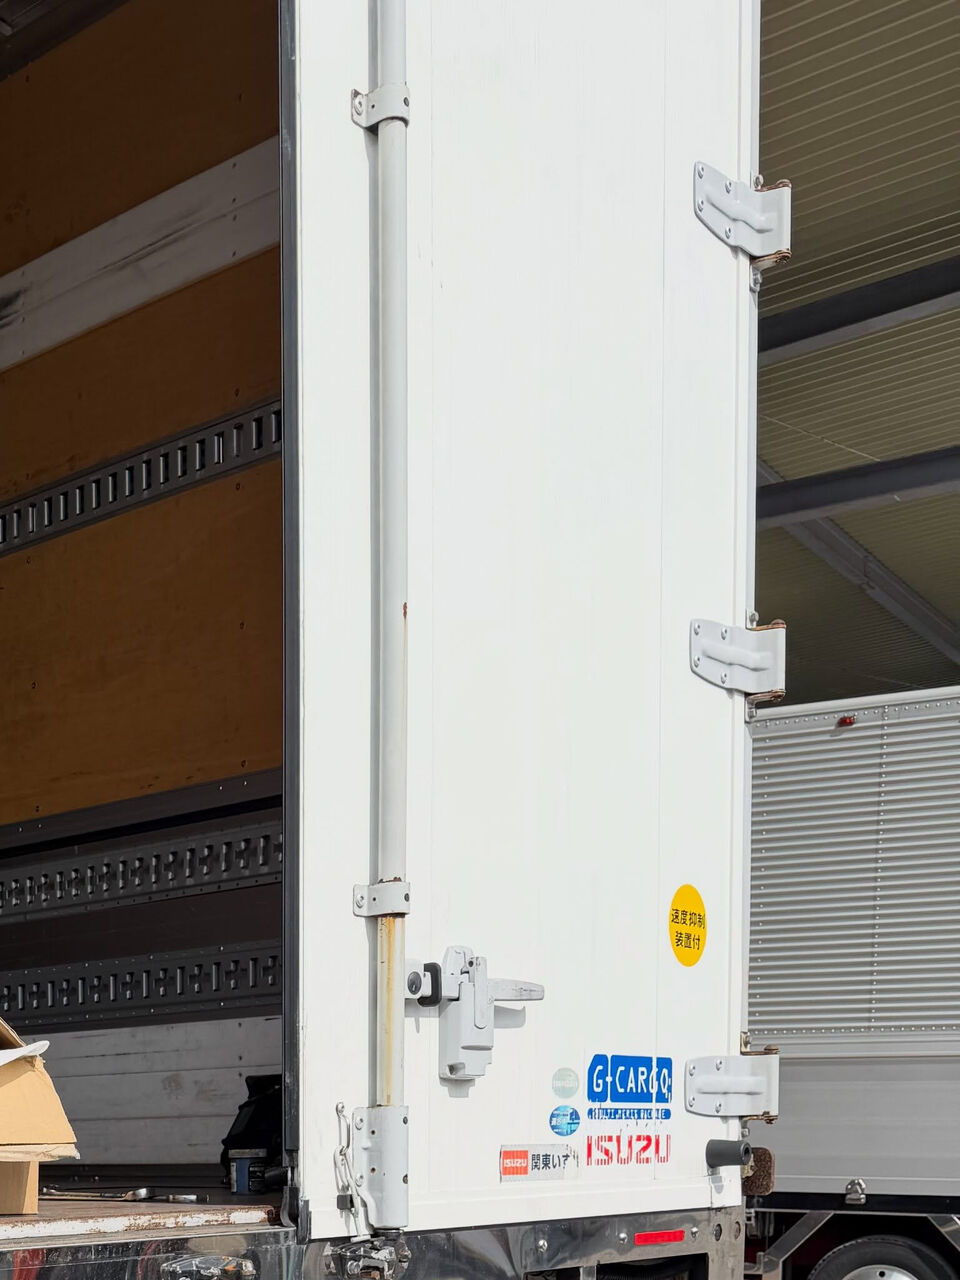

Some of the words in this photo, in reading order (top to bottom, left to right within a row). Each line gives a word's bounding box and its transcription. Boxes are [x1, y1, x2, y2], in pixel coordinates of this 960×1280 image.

[675, 931, 701, 950] 装置付
[586, 1134, 671, 1166] ISUZU
